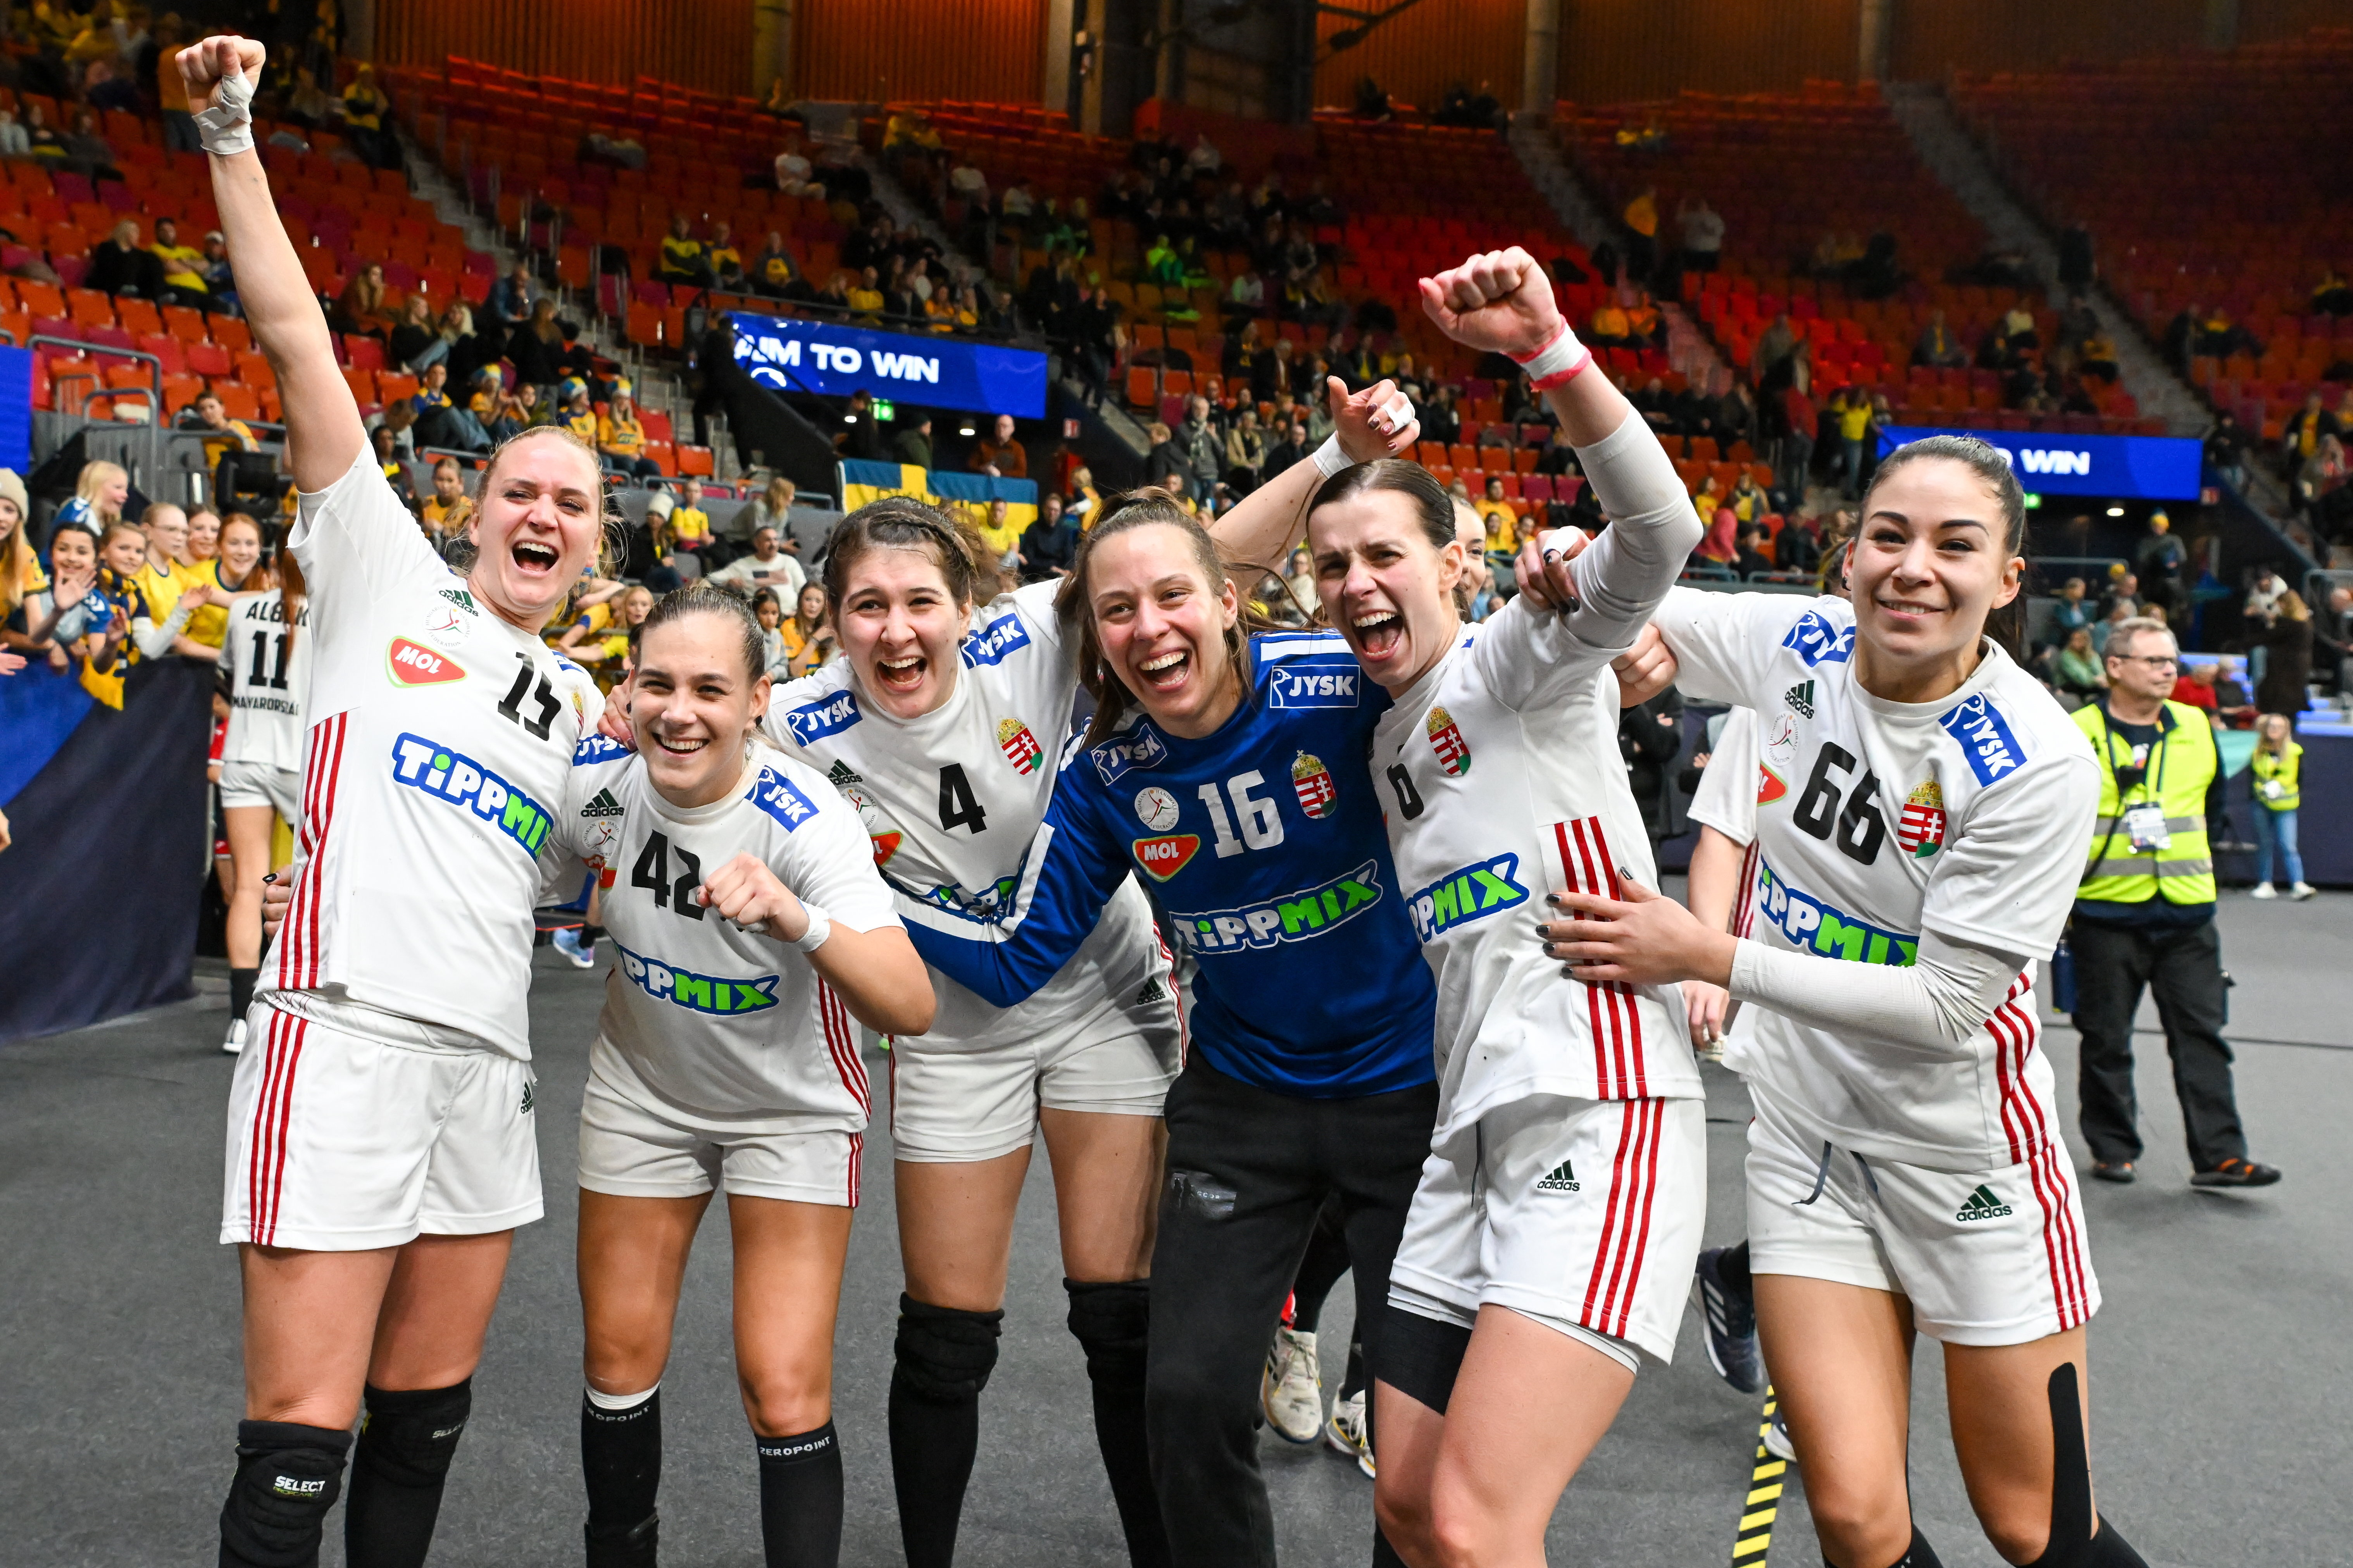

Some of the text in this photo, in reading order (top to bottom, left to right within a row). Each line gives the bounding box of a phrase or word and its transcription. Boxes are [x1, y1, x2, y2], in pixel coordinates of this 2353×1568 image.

[734, 334, 939, 384] AIM TO WIN
[2020, 448, 2091, 476] WIN
[245, 601, 309, 627] ALBK
[438, 589, 479, 617] adidas
[428, 631, 461, 647] FEDERATION
[248, 630, 288, 690] 11
[395, 646, 443, 674] MOL
[498, 651, 562, 741] 15
[1289, 675, 1354, 697] JYSK
[808, 695, 856, 731] JYSK
[1784, 691, 1815, 719] adidas
[578, 736, 626, 756] JYS
[1110, 734, 1161, 768] JYSK
[1963, 715, 2017, 777] JYSK
[581, 807, 625, 817] adidas
[938, 763, 987, 834] 4
[1138, 789, 1177, 821] HUNGARIAN HANDBALL
[1793, 741, 1886, 866] 66
[1198, 769, 1284, 858] 16
[1144, 842, 1179, 861] MOL
[631, 829, 706, 921] 42
[1136, 991, 1166, 1005] adidas
[1537, 1179, 1581, 1192] adidas
[1956, 1205, 2013, 1222] adidas
[760, 1436, 830, 1456] ZEROPOINT
[274, 1475, 326, 1492] SELECT
